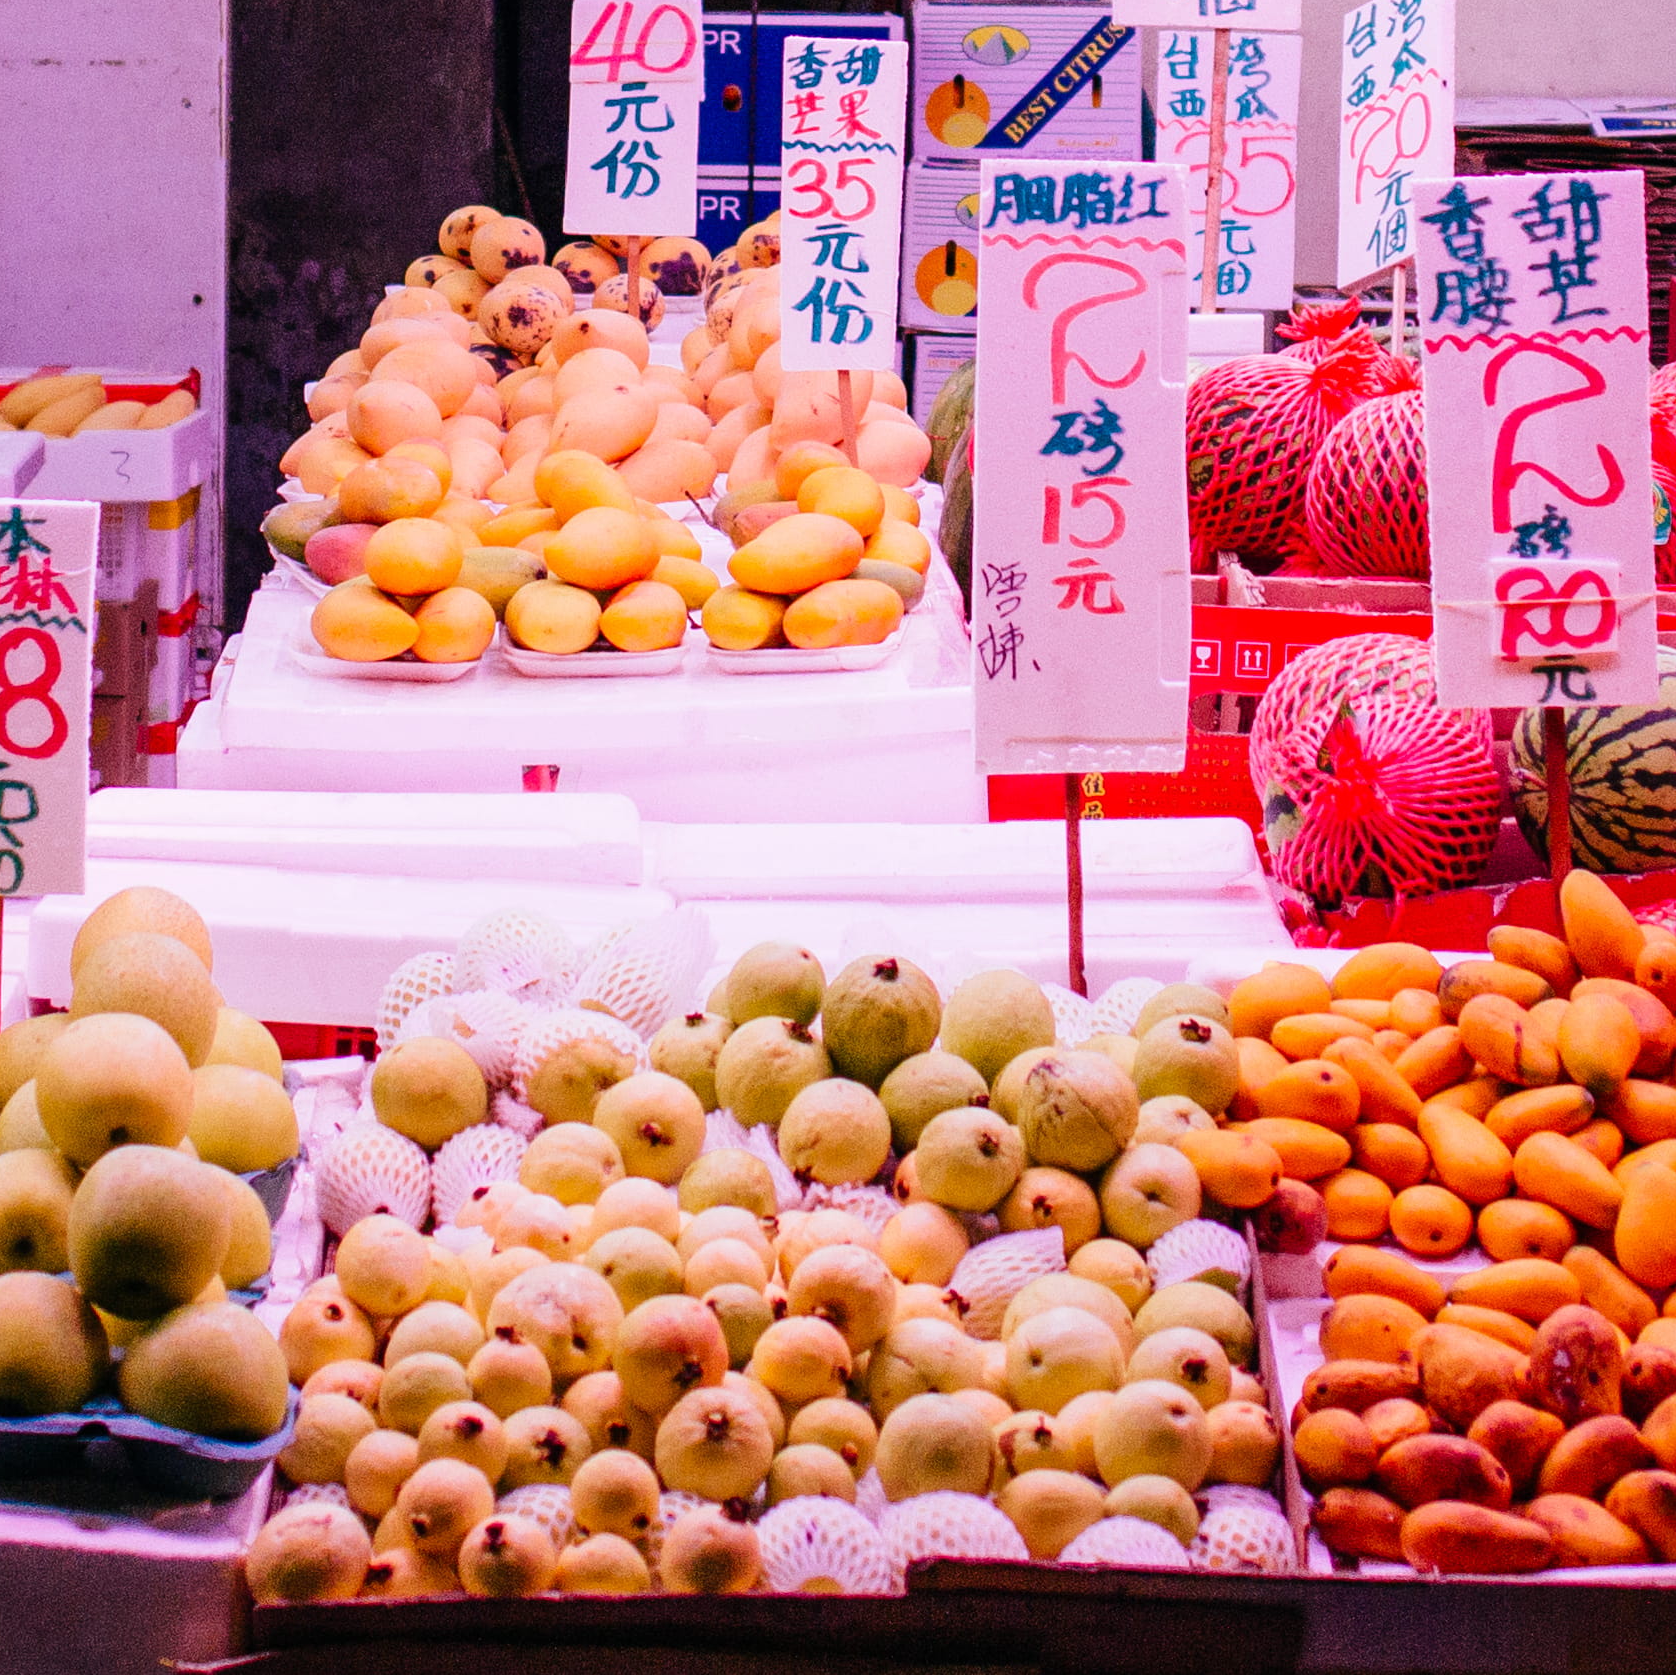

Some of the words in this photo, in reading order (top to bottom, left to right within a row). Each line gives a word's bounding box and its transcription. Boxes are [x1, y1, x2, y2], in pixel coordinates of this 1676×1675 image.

[570, 1, 696, 81] 40
[788, 41, 885, 89] 香甜
[1003, 95, 1051, 144] BEST
[1052, 21, 1128, 96] CITRUS
[787, 90, 881, 140] 芒果
[788, 158, 877, 221] 35
[983, 171, 1169, 229] 胭脂红
[1175, 132, 1295, 216] 35
[1420, 179, 1611, 260] 香甜
[1041, 477, 1133, 549] 15
[1053, 558, 1125, 616] 元
[1531, 655, 1596, 704] 元
